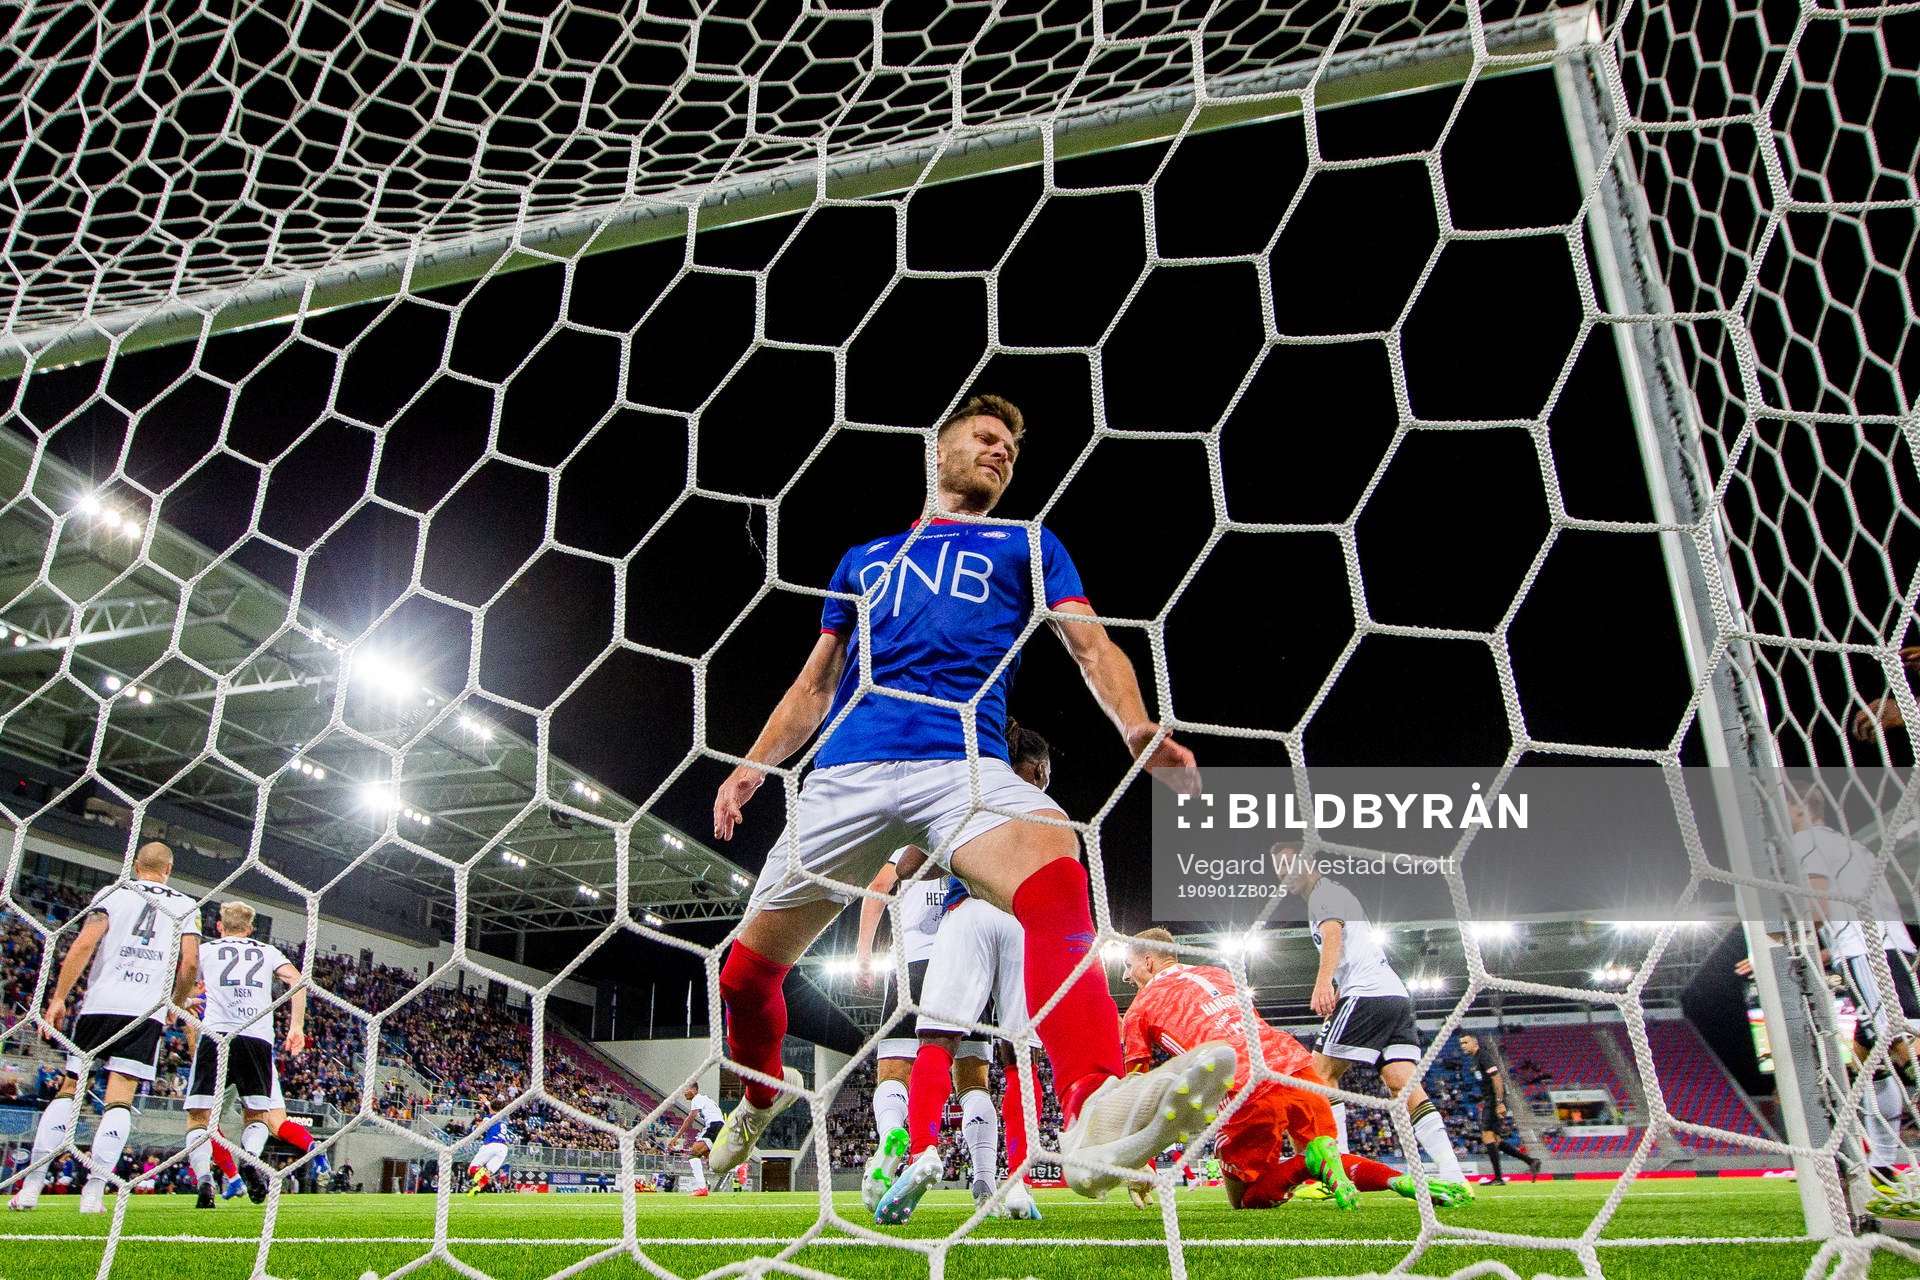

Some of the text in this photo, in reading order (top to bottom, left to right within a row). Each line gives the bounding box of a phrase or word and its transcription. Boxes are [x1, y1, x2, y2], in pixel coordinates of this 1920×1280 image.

[859, 541, 994, 617] DNB
[131, 902, 158, 946] 4
[123, 970, 151, 984] MOT
[218, 946, 264, 988] 22
